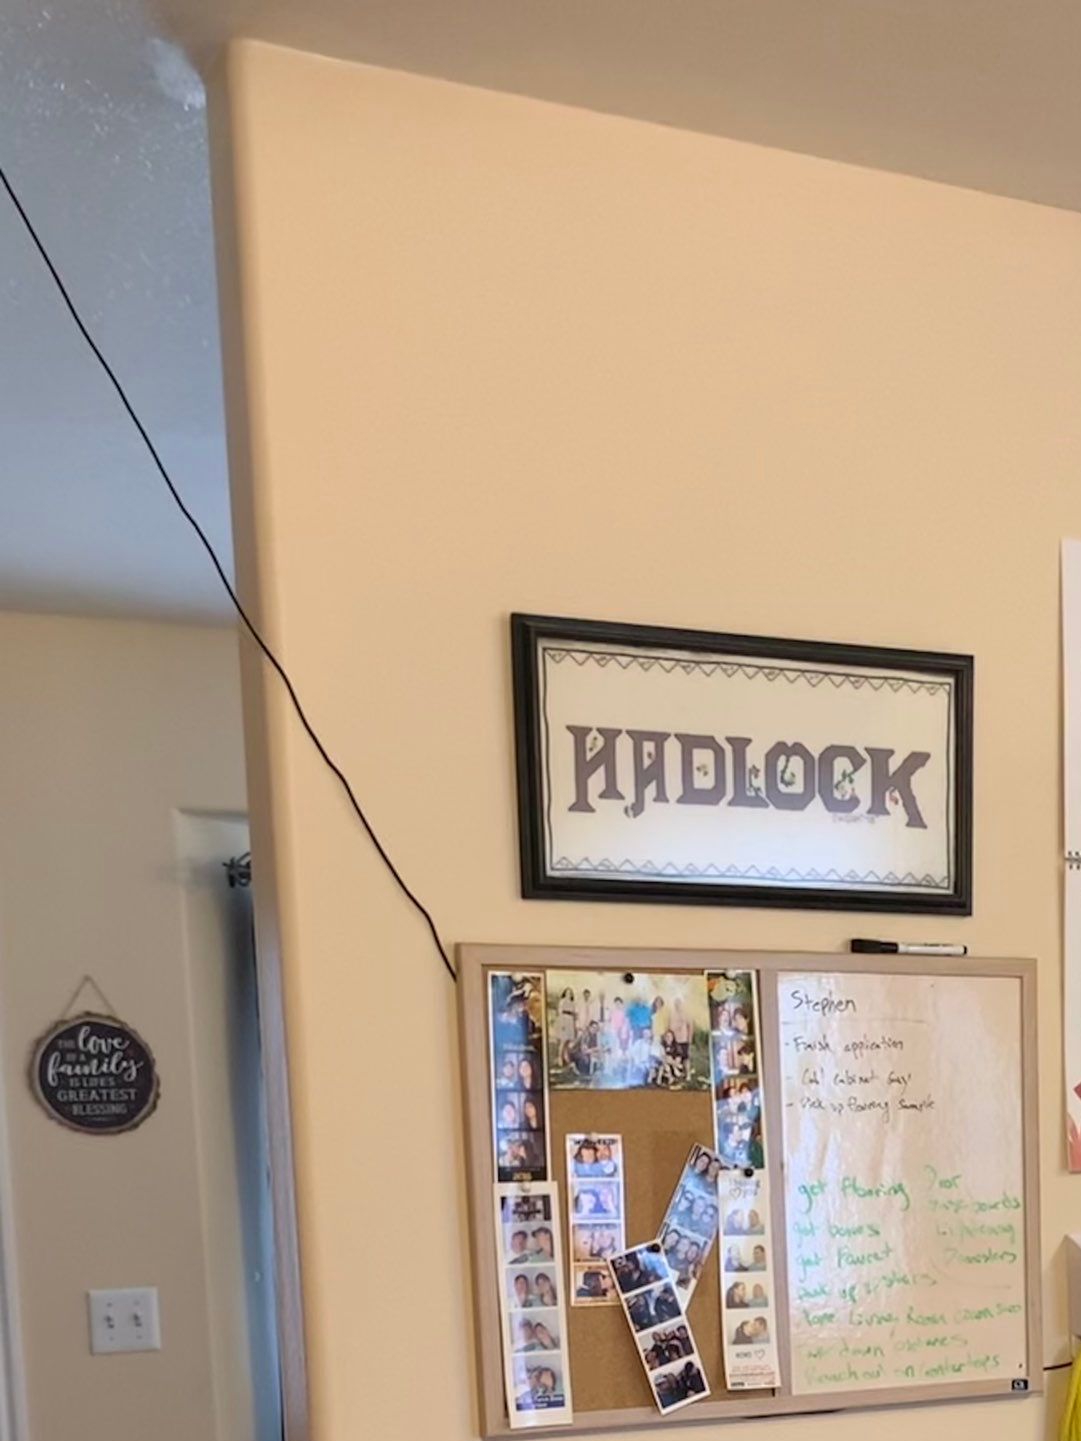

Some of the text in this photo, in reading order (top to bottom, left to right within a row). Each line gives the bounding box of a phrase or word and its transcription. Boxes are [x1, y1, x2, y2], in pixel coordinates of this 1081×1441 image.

[564, 725, 931, 829] HADLOCK
[791, 990, 857, 1016] Stephen
[78, 1025, 130, 1054] love
[844, 1034, 904, 1060] application
[47, 1051, 144, 1087] family
[57, 1088, 138, 1102] GREATEST
[72, 1103, 128, 1116] BLESSING
